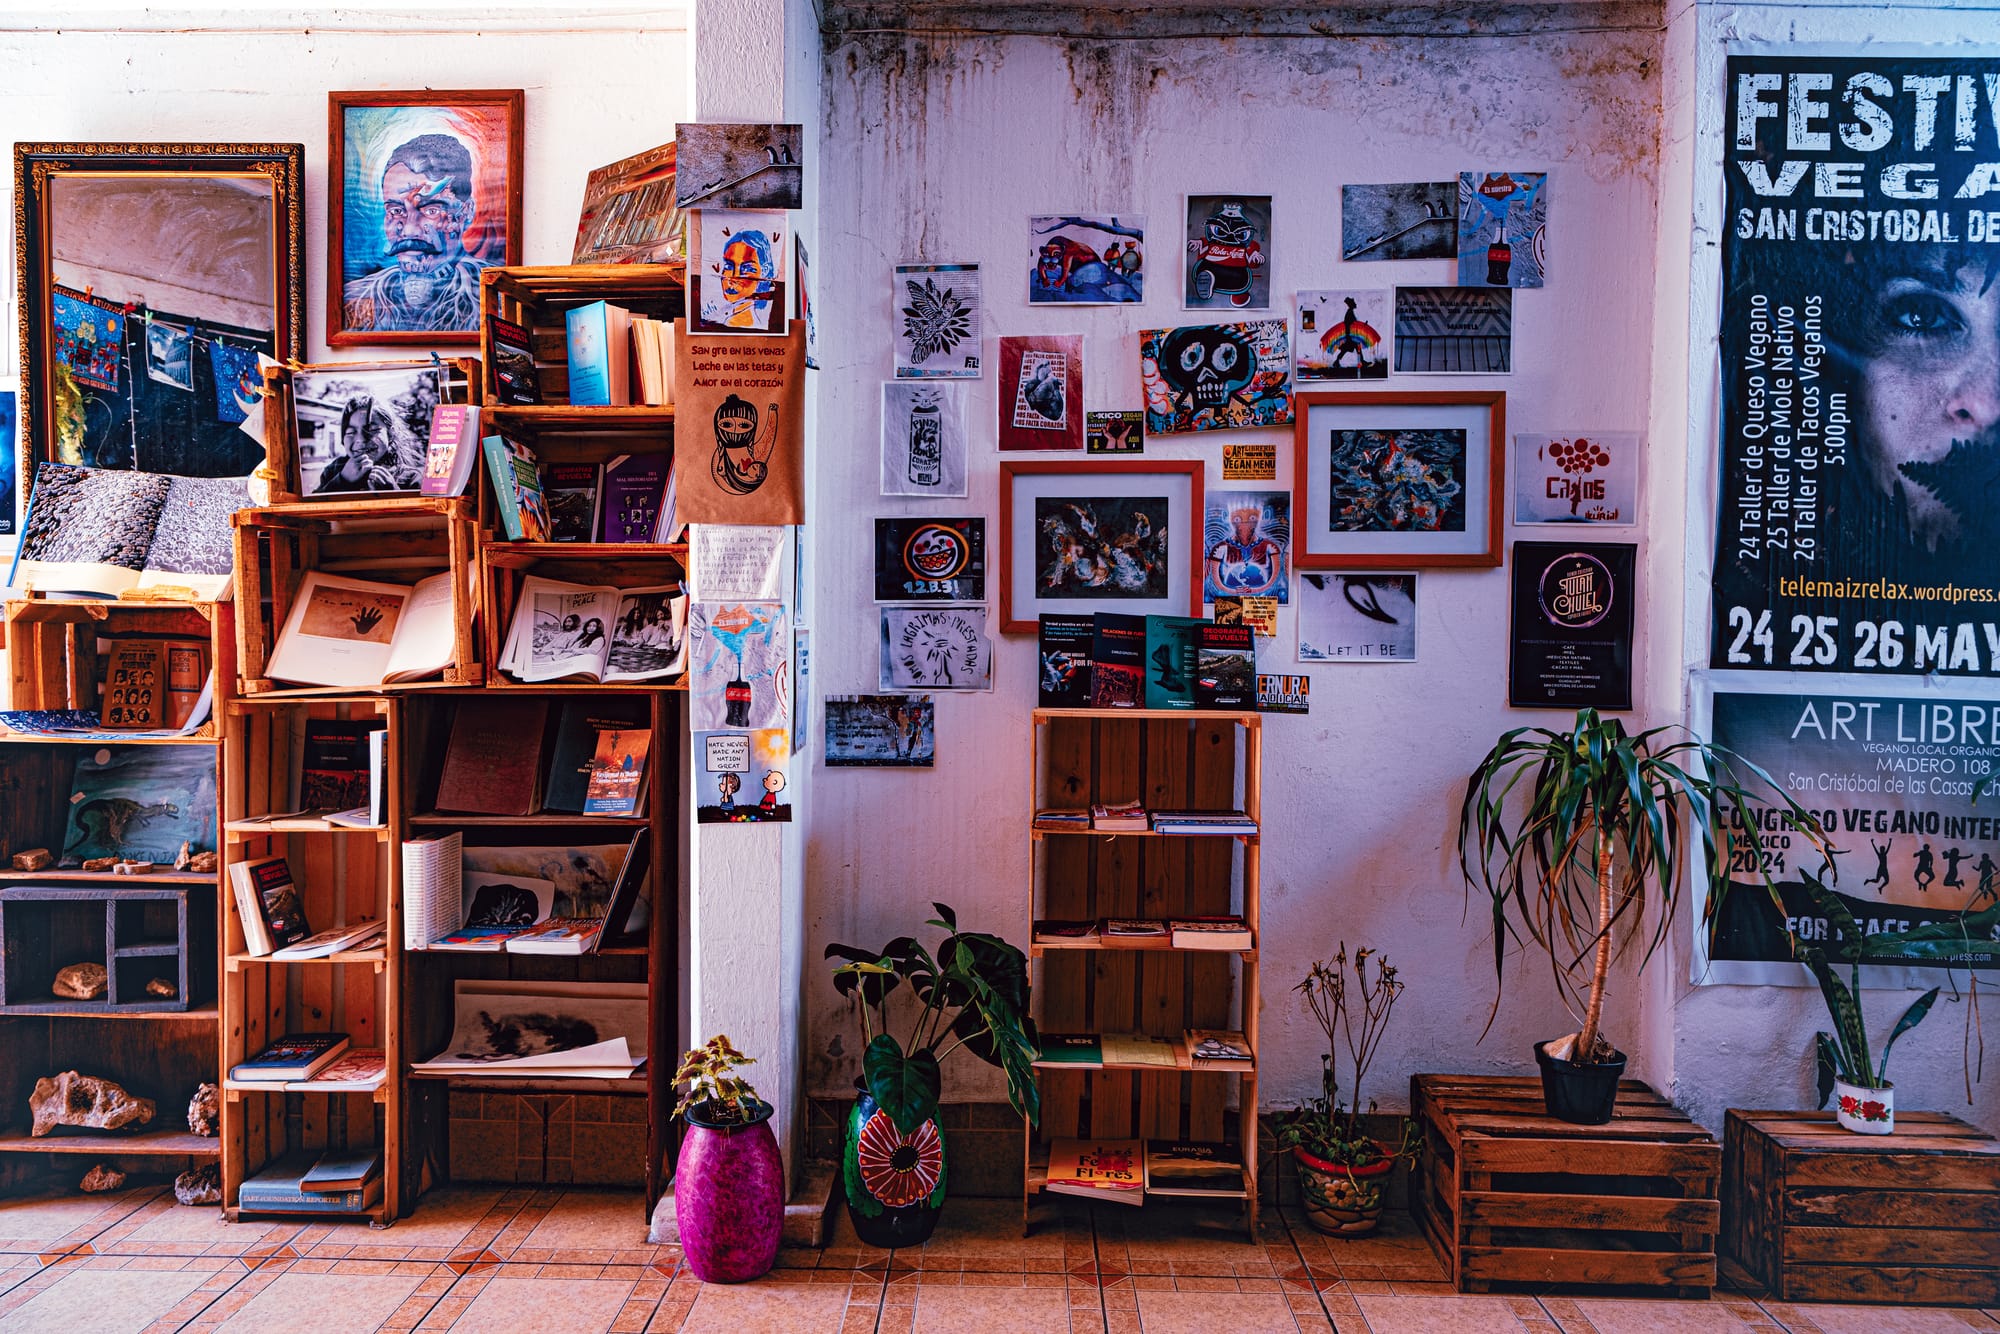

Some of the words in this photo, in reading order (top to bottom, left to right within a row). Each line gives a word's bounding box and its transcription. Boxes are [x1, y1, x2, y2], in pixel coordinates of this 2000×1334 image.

[1737, 160, 2000, 199] VEGA
[1737, 208, 1797, 240] SAN
[1805, 208, 1959, 242] CRISTOBAL
[1967, 209, 2000, 242] DE
[1745, 294, 1771, 371] Vegano
[1771, 305, 1794, 371] Nativo
[1799, 295, 1825, 384] Veganos
[692, 346, 710, 355] San
[711, 346, 728, 357] gre
[743, 347, 756, 356] las
[758, 347, 785, 356] venas
[693, 361, 721, 371] Leche
[736, 362, 750, 371] las
[751, 362, 776, 372] tetas
[778, 363, 784, 374] y
[720, 379, 732, 387] en
[734, 378, 742, 387] el
[744, 378, 784, 388] corazón
[1742, 376, 1768, 438] Queso
[1770, 379, 1793, 429] Mole
[1797, 385, 1820, 439] Tacos
[1824, 392, 1851, 466] 5:00pm
[1740, 438, 1764, 469] de
[1768, 435, 1791, 459] de
[1795, 446, 1818, 472] de
[1223, 460, 1251, 469] VEGAN
[1253, 460, 1276, 469] MENU
[1739, 473, 1763, 529] Taller
[1767, 464, 1790, 520] Taller
[1793, 478, 1817, 532] Taller
[1739, 537, 1760, 559] 24
[1767, 527, 1789, 549] 25
[1794, 540, 1815, 561] 26
[1780, 575, 2000, 604] telemaizrelax.wordpress.
[1203, 627, 1248, 635] GEOGRAFÍAS
[1209, 634, 1249, 642] REVUELTA
[1728, 607, 1774, 664] 24
[1790, 615, 1838, 665] 25
[1854, 621, 1904, 667] 26
[1328, 644, 1352, 656] LET
[1360, 644, 1374, 656] IT
[1380, 644, 1397, 656] BE
[901, 655, 926, 684] SOMOS
[1258, 675, 1309, 695] ERNURA
[1258, 694, 1310, 704] ADICAL
[1791, 701, 1880, 742] ART
[1862, 743, 1909, 754] VEGANO
[1912, 744, 1948, 755] LOCAL
[1876, 757, 1956, 774] MADERO
[1963, 760, 1991, 775] 108
[1788, 772, 1815, 792] San
[1817, 773, 1881, 794] Cristóbal
[1884, 776, 1905, 793] de
[1908, 776, 1926, 794] las
[1718, 805, 1838, 833] CONGRSO
[1842, 808, 1940, 835] VEGANO
[1732, 849, 1785, 873] 2024
[1786, 917, 1828, 941] FOR
[1079, 1155, 1133, 1167] Fee
[1076, 1168, 1133, 1180] Flores
